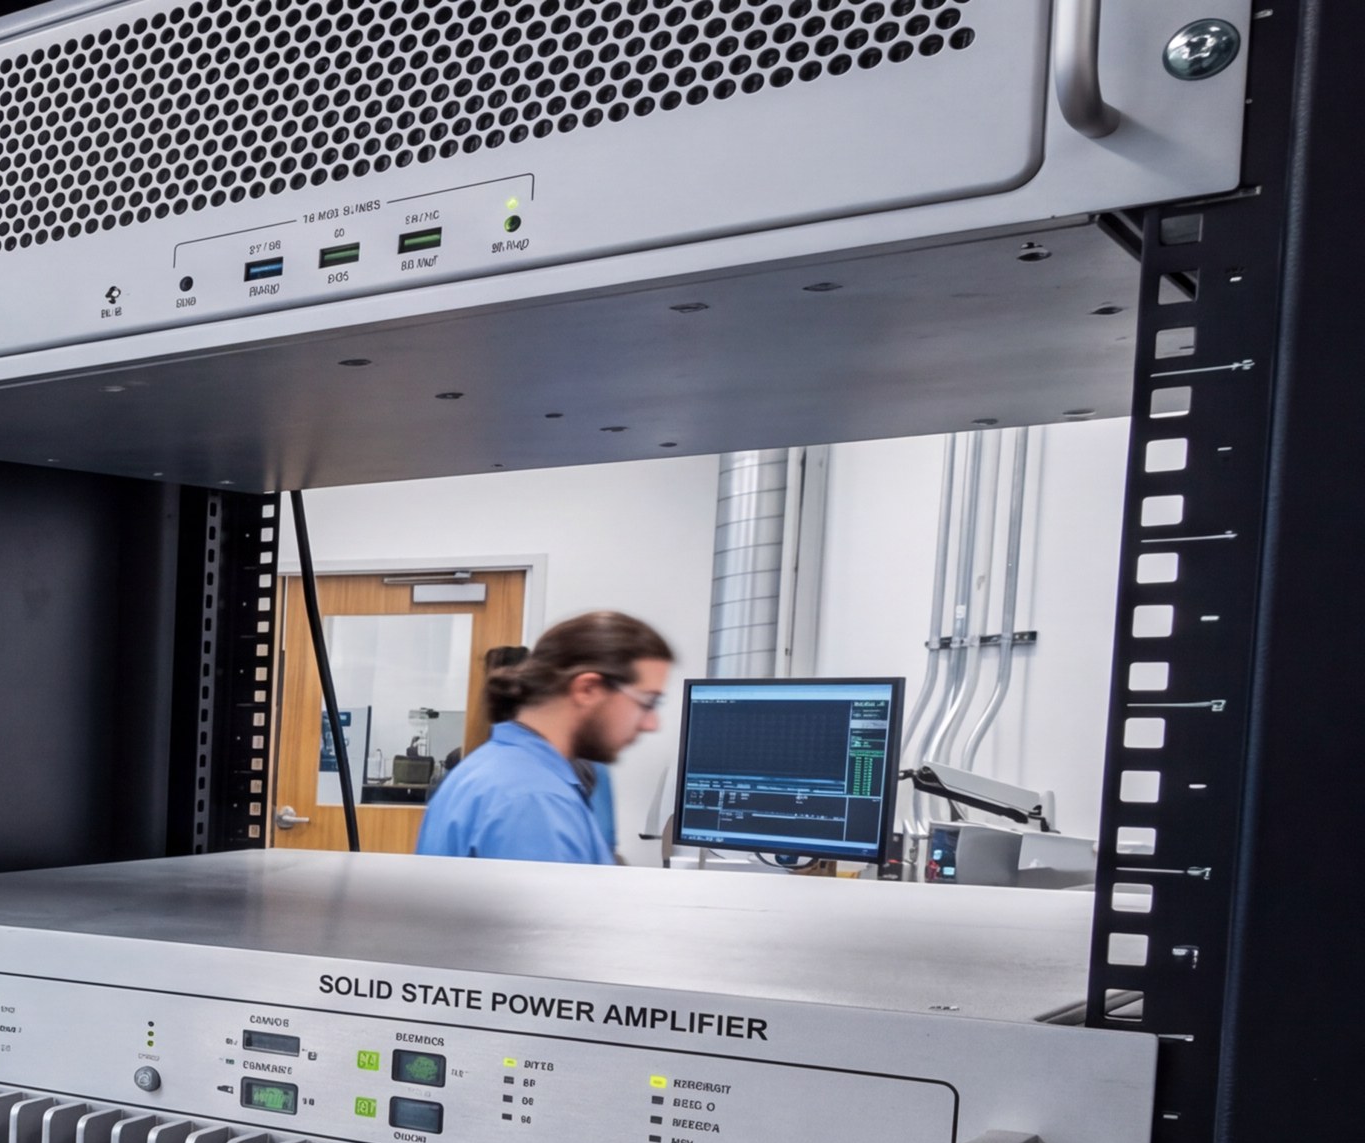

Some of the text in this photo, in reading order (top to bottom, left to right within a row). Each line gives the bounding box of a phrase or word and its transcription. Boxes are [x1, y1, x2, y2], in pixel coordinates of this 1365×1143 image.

[318, 974, 769, 1041] SOLID STATE POWER AMPLIFIER
